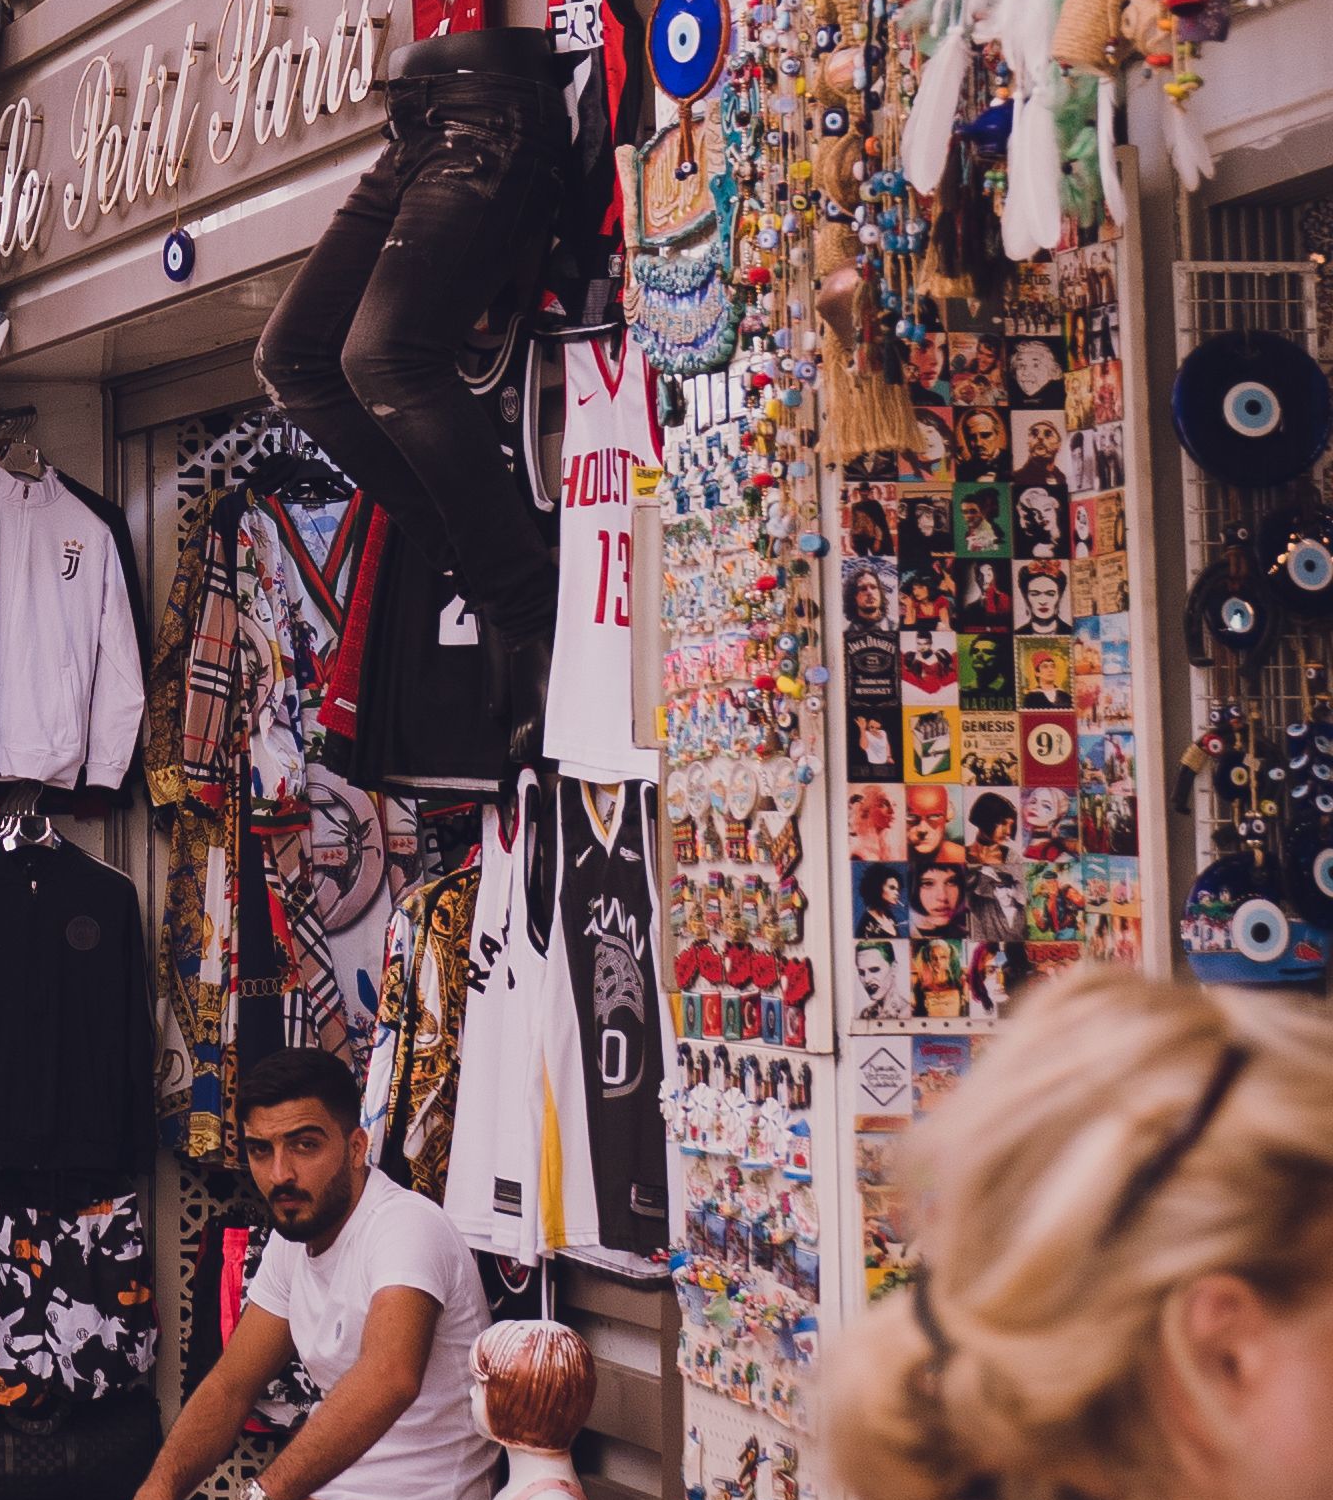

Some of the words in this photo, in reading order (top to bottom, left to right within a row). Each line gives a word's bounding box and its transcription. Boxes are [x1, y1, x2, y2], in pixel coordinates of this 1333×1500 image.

[63, 21, 200, 231] Petit
[562, 447, 646, 508] HOUST
[962, 697, 1014, 710] NARCOS
[962, 719, 1015, 733] GENESIS
